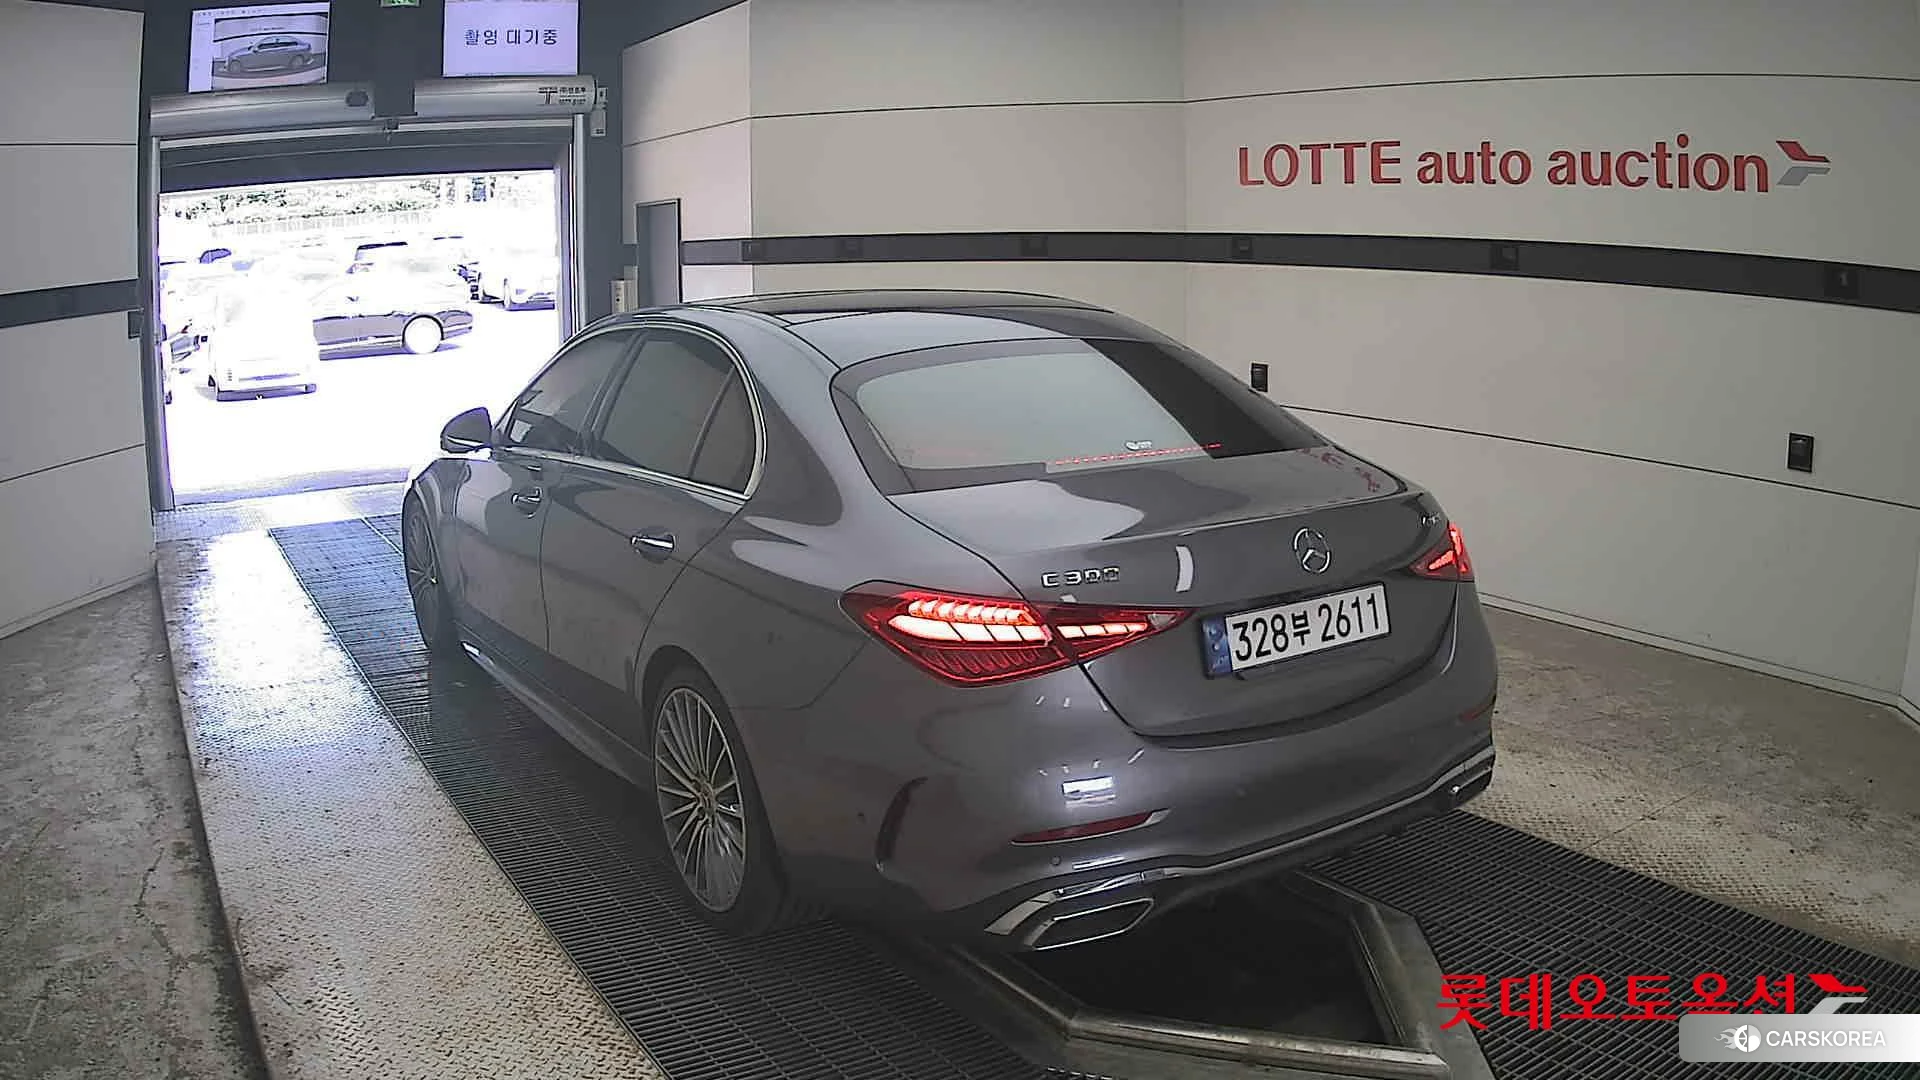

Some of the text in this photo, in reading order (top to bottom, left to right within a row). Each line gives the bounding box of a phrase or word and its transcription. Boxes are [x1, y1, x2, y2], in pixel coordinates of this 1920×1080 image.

[465, 28, 558, 46] 촬영 대기중
[1239, 134, 1769, 193] LOTTE auto auction
[1041, 566, 1120, 588] C 300
[1231, 592, 1380, 662] 328부 2611
